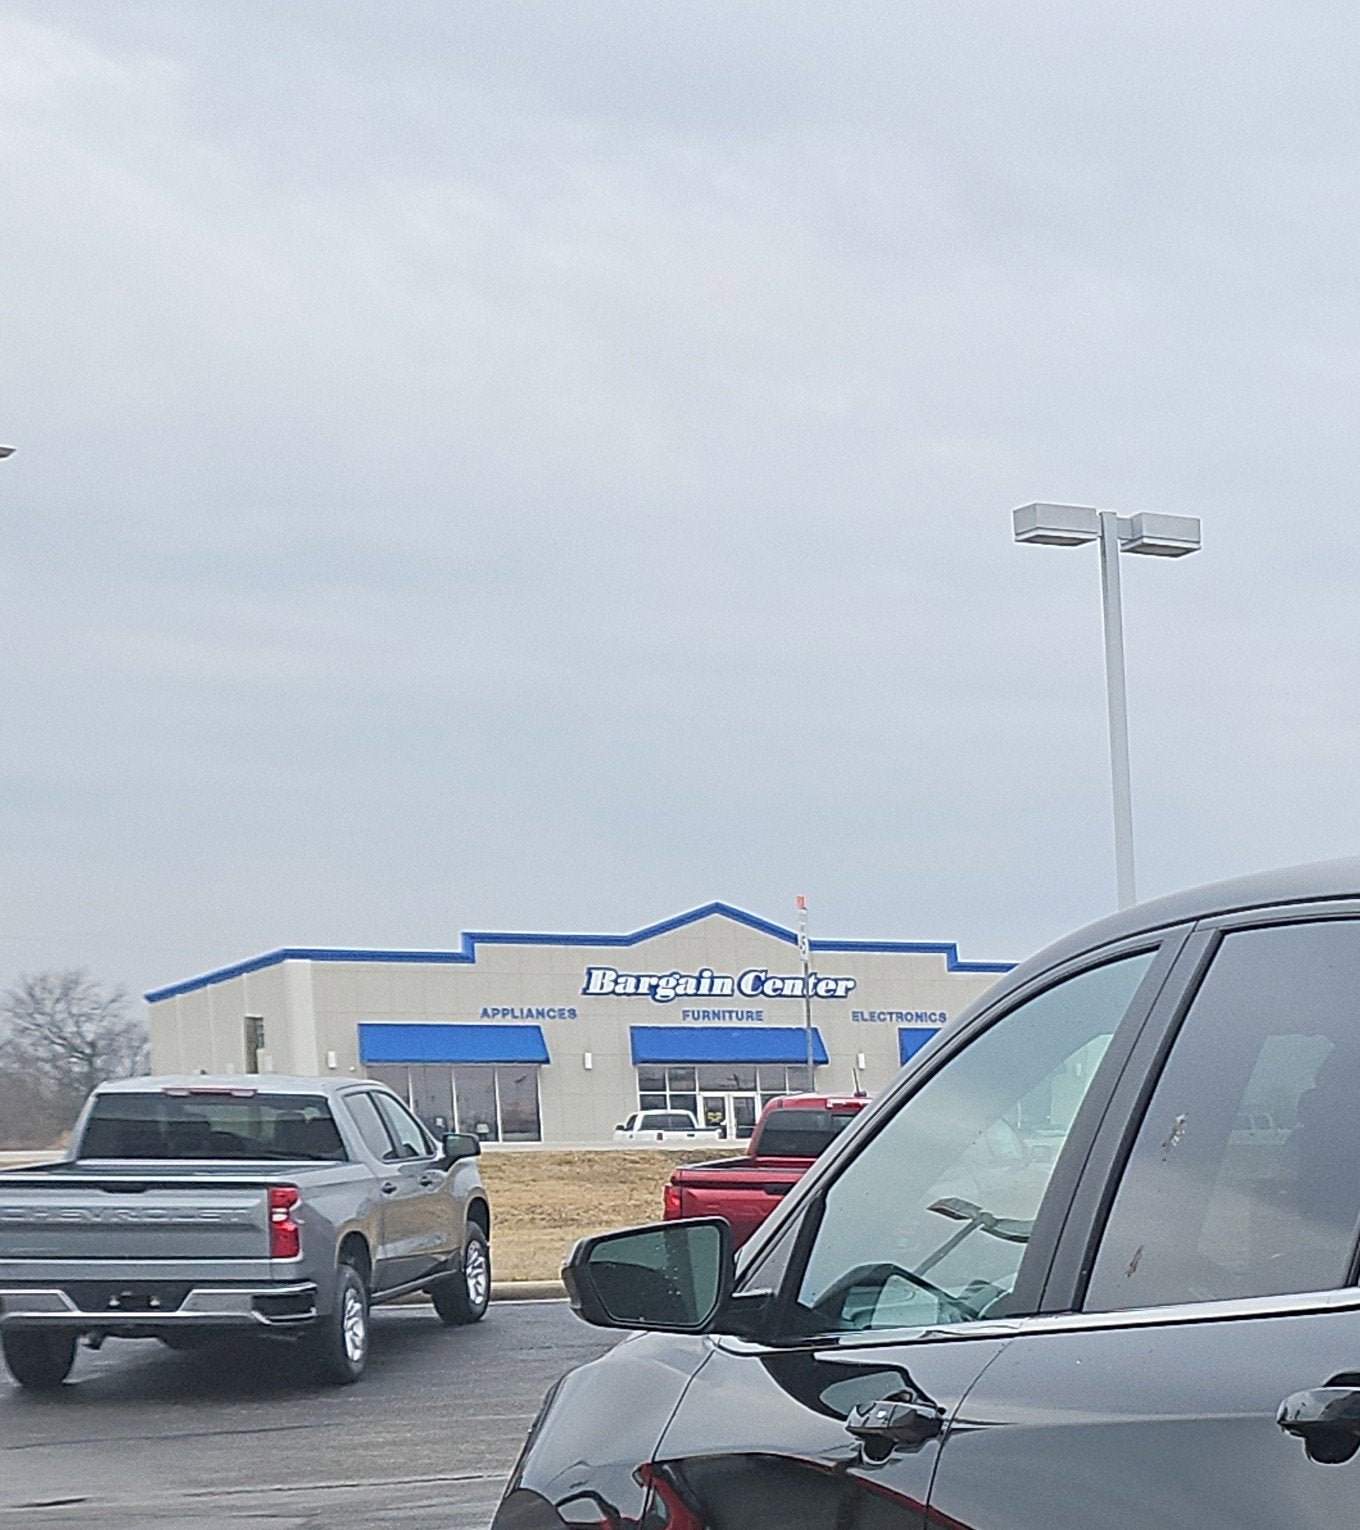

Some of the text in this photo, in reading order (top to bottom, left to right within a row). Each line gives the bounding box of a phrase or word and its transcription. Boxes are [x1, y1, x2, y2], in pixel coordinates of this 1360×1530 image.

[579, 966, 857, 1003] Bargain Center
[480, 1007, 578, 1020] APPLIANCES
[682, 1009, 764, 1022] FURNITURE
[852, 1010, 947, 1023] ELECTRONICS
